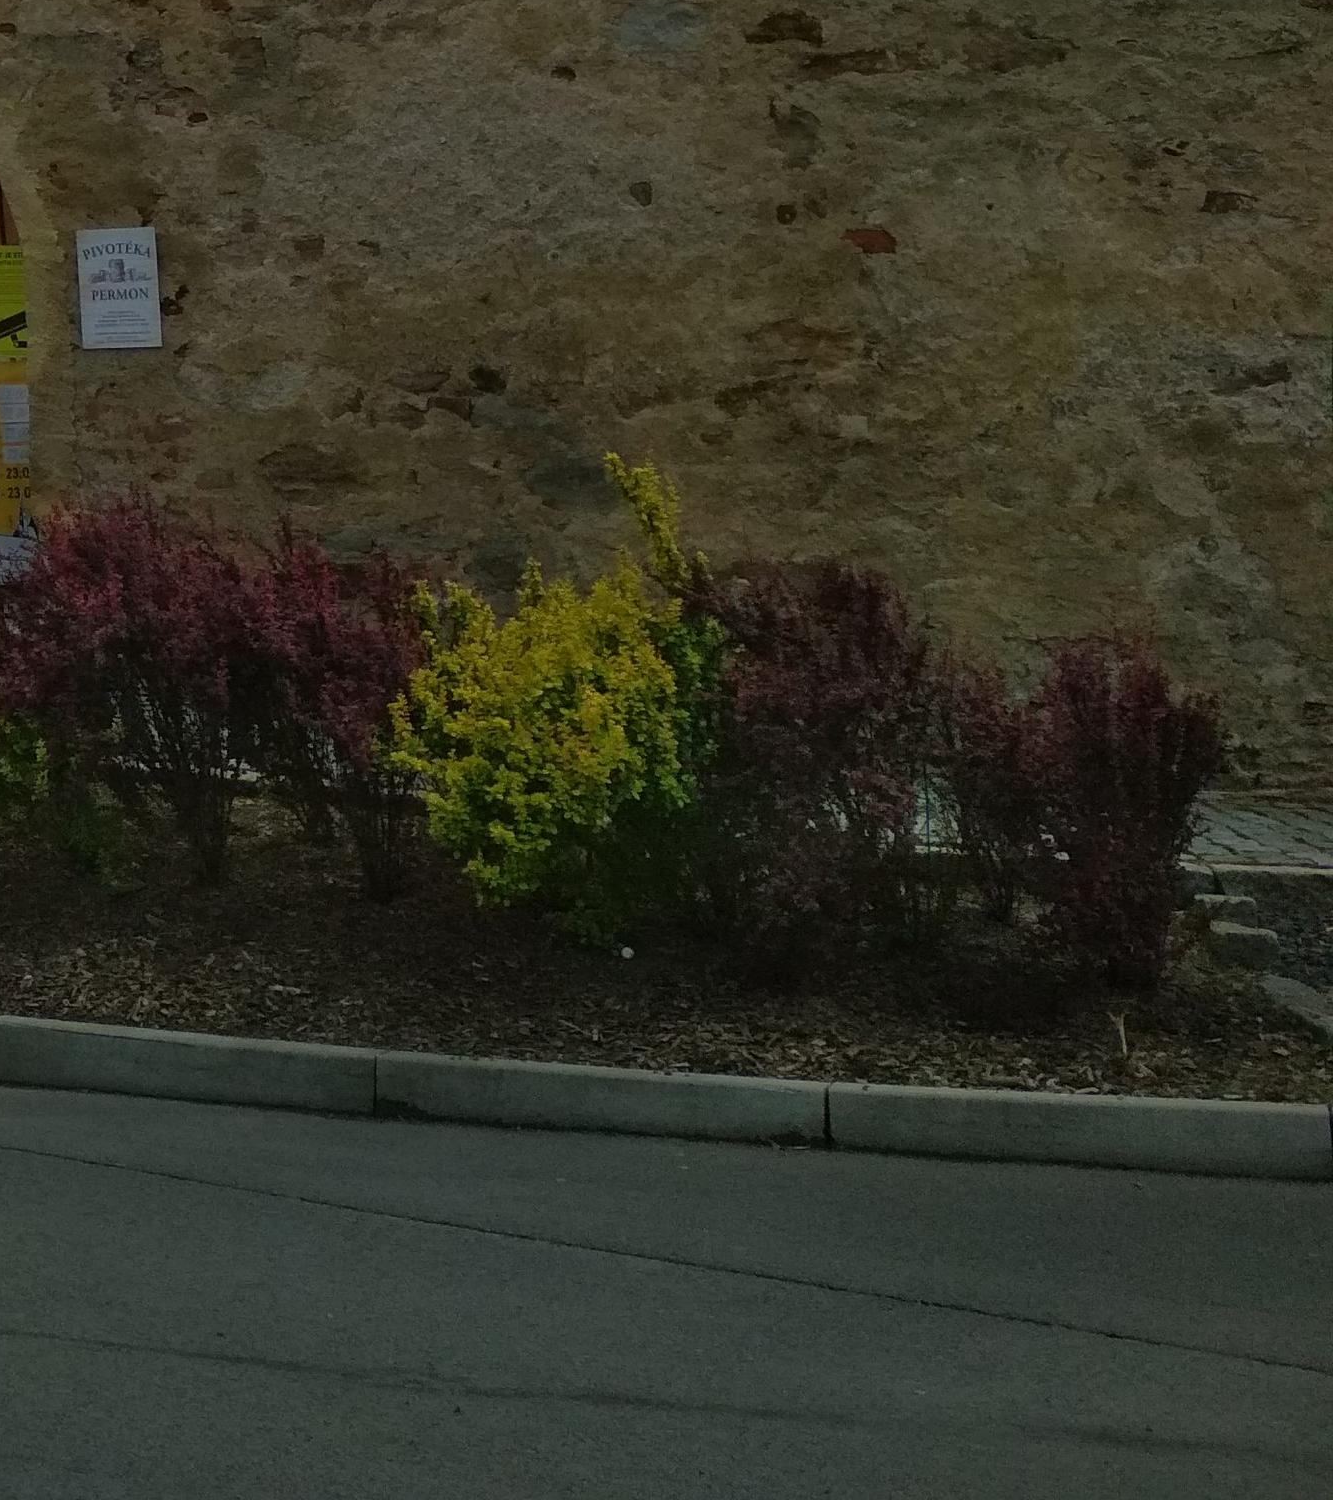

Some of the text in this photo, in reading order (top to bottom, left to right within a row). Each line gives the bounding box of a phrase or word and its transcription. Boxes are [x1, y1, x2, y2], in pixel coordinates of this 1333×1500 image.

[82, 240, 150, 260] PIVOTÉKA
[91, 287, 150, 301] PERMON
[6, 467, 30, 479] 23:0
[7, 487, 31, 499] 230
